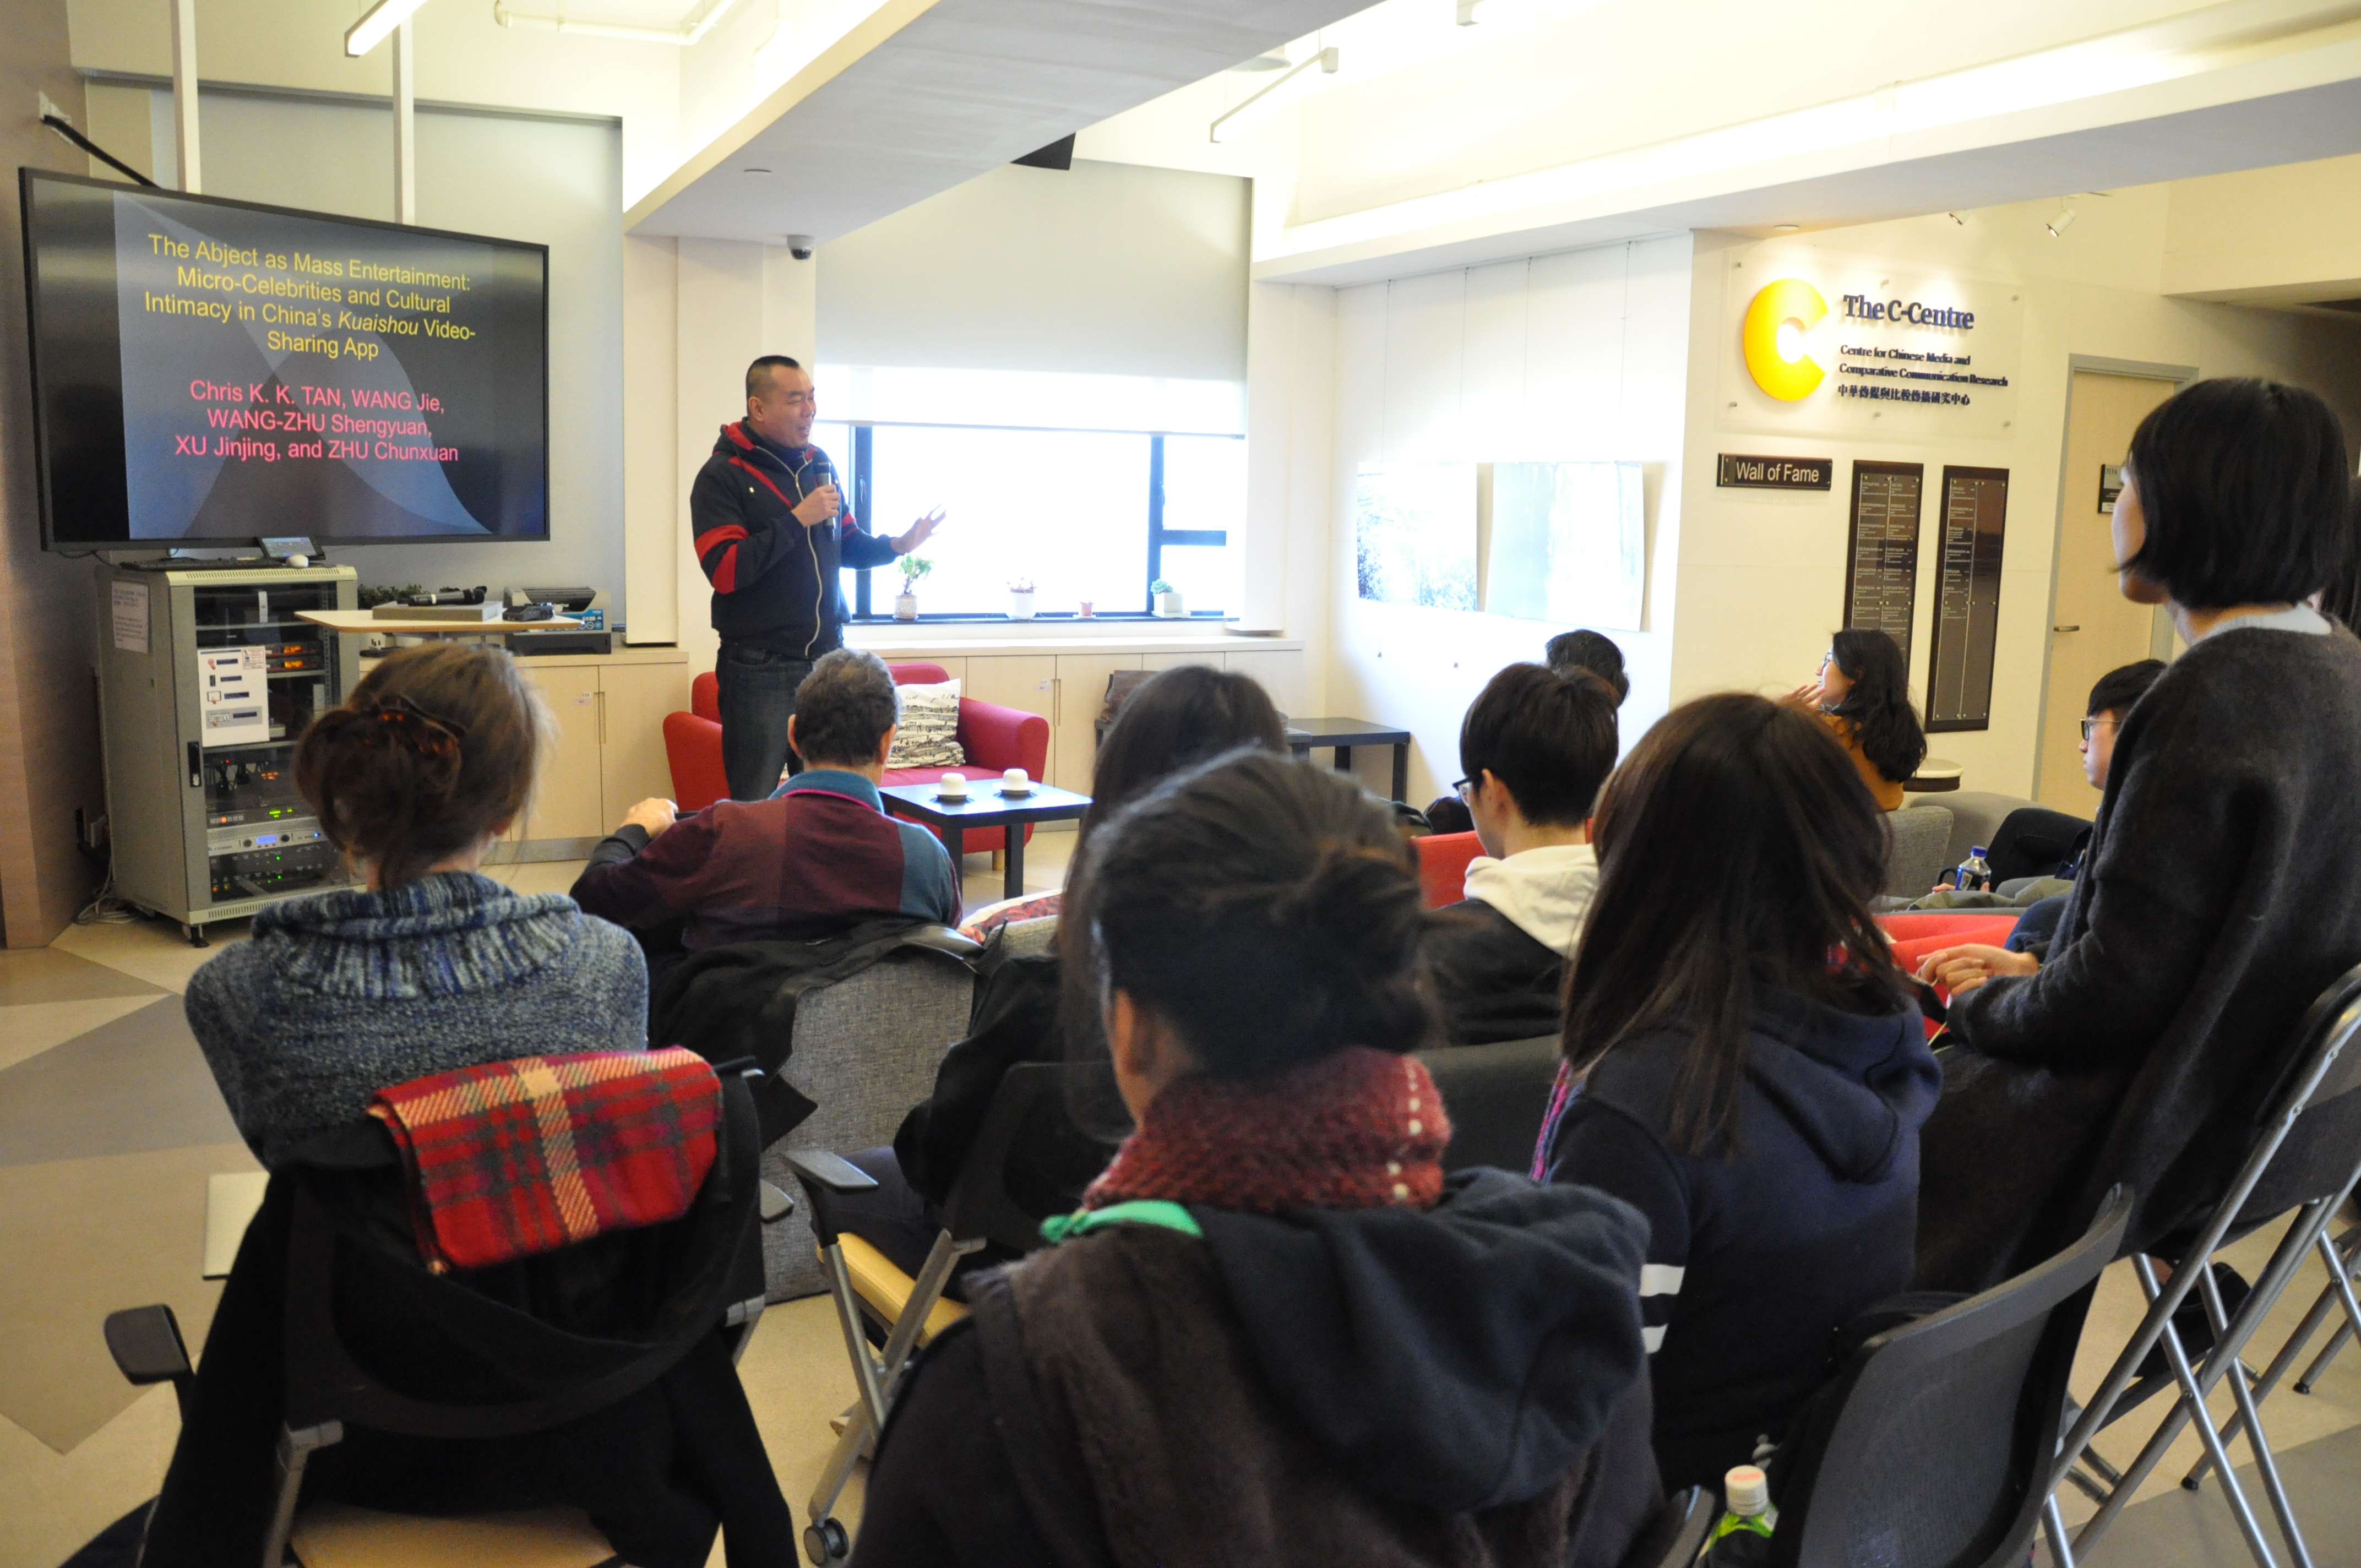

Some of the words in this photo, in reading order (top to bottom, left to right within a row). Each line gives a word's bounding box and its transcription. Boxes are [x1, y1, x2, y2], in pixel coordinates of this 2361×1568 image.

[148, 234, 189, 259] The
[195, 241, 258, 268] Abject
[265, 253, 287, 270] as
[294, 252, 343, 276] Mass
[349, 259, 470, 291] Entertainment:
[177, 266, 342, 302] Micro-Celebrities
[347, 288, 380, 307] and
[386, 289, 450, 313] Cultural
[145, 291, 232, 323] Intimacy
[238, 301, 255, 320] in
[338, 310, 419, 335] Kuaishou
[423, 318, 476, 340] Video-
[1843, 294, 1885, 320] The
[1887, 300, 1975, 329] C-Centre
[268, 330, 339, 359] Sharing
[343, 337, 379, 361] App
[1840, 345, 1873, 357] Centre
[1874, 347, 1887, 358] for
[1888, 349, 1925, 361] Chinese
[1926, 352, 1953, 364] Media
[1954, 355, 1971, 366] and
[1839, 363, 1898, 377] Comparative
[1900, 368, 1969, 383] Communication
[1969, 374, 2009, 386] Research
[190, 379, 244, 402] Chris
[249, 383, 269, 404] K.
[276, 384, 295, 405] K.
[301, 386, 347, 410] TAN,
[351, 389, 412, 410] WANG
[416, 393, 445, 414] Jie,
[206, 409, 326, 432] WANG-ZHU
[331, 413, 432, 439] Shengyuan,
[175, 435, 208, 455] XU
[214, 436, 281, 462] Jinjing,
[288, 439, 323, 458] and
[328, 439, 369, 460] ZHU
[374, 441, 459, 461] Chunxuan
[1736, 461, 1764, 480] Wall
[1767, 464, 1781, 481] of
[1783, 464, 1819, 482] Fame
